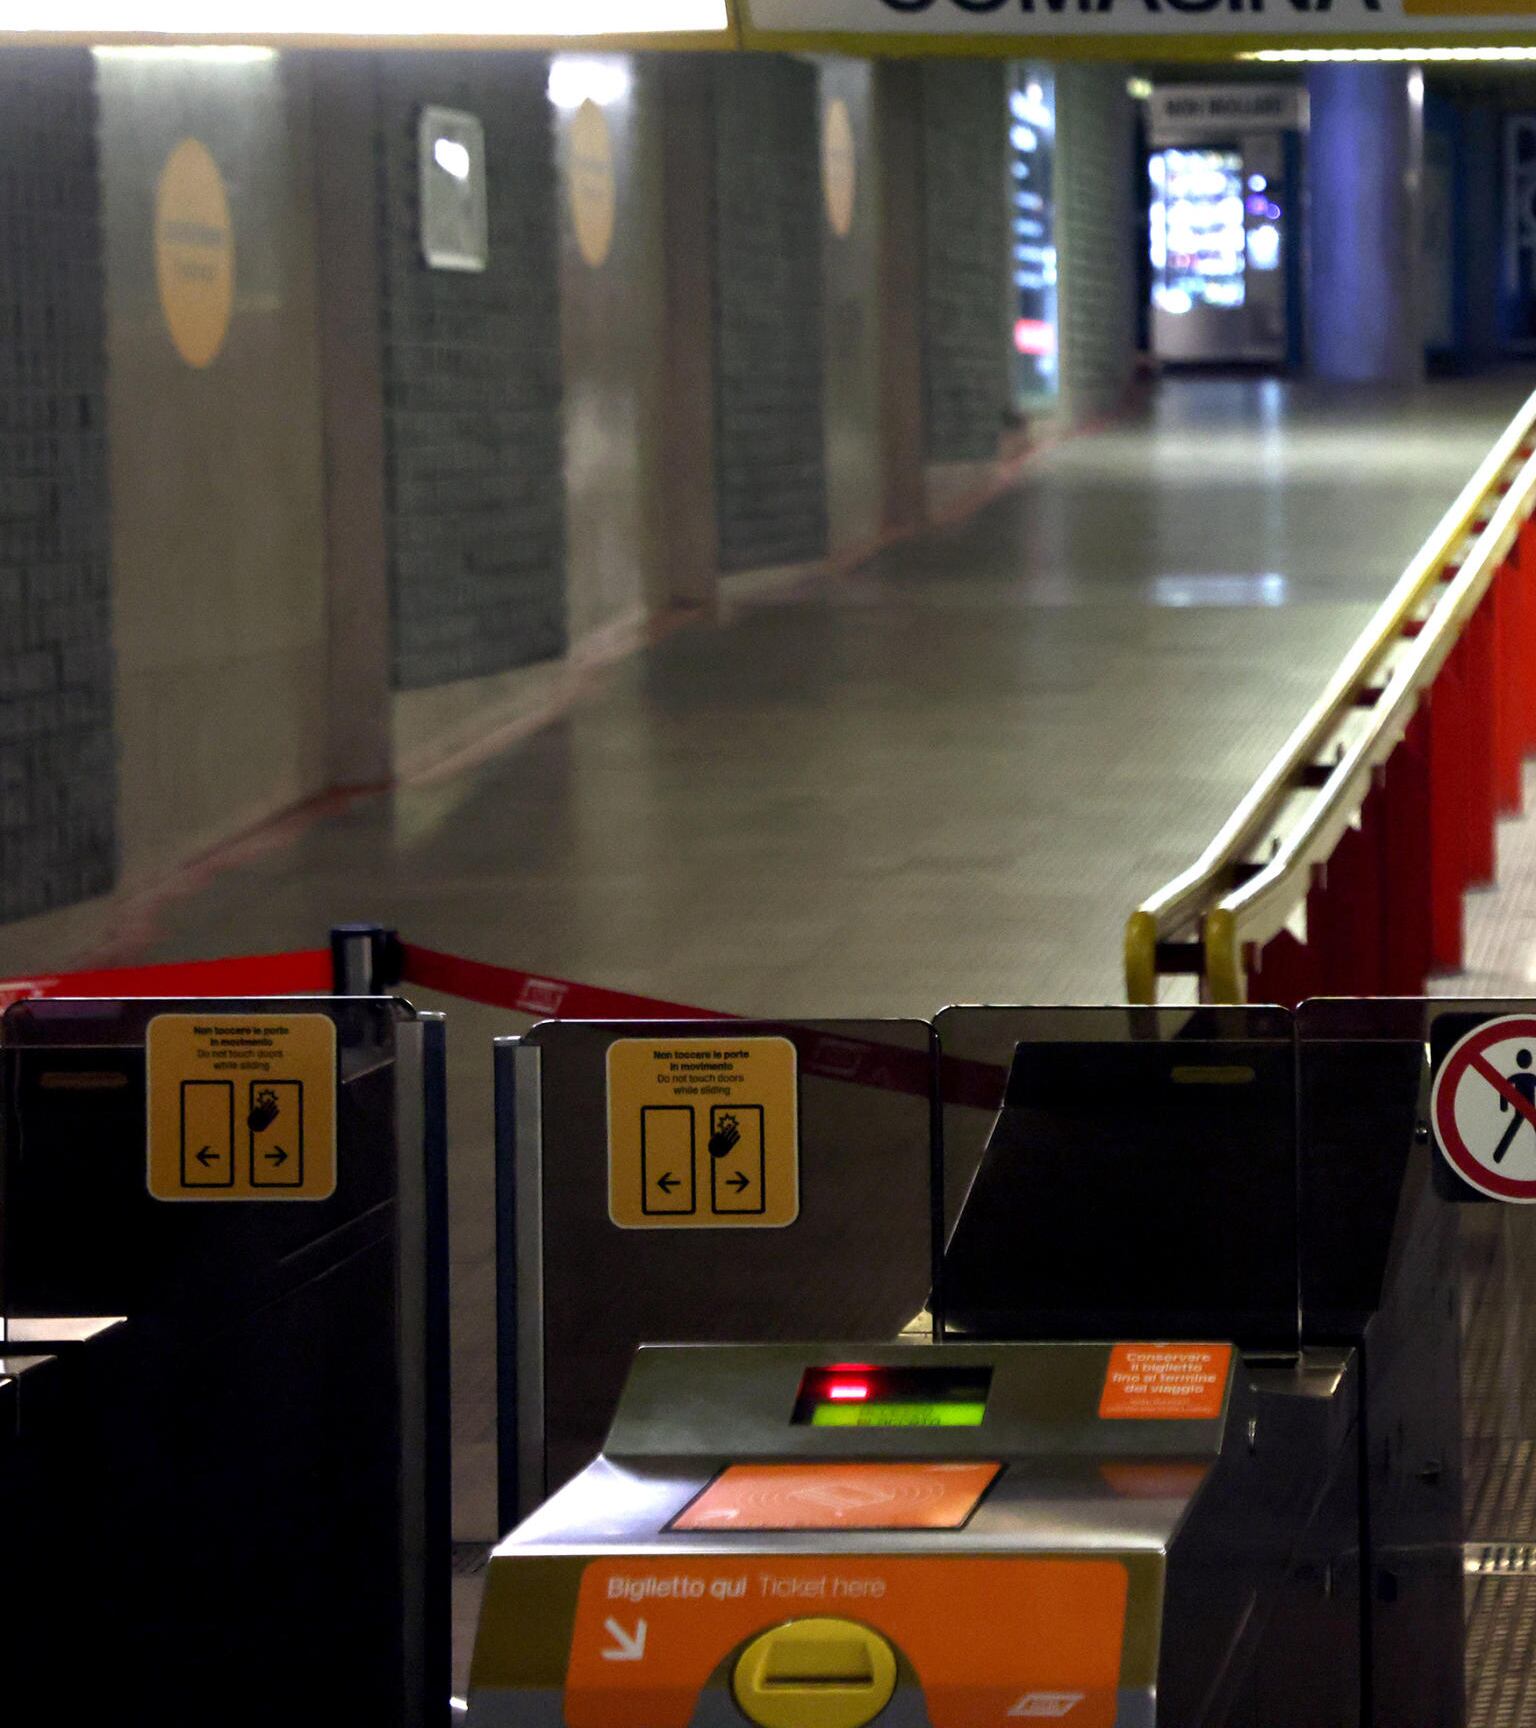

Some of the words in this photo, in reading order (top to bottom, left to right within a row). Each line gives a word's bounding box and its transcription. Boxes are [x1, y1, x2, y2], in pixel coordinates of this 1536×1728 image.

[194, 1026, 213, 1035] Non
[214, 1026, 251, 1036] toccare
[263, 1026, 289, 1036] porte
[221, 1038, 273, 1047] movimento
[197, 1049, 210, 1058] Do
[211, 1050, 227, 1058] not
[653, 1050, 673, 1060] Non
[674, 1050, 712, 1060] toccare
[713, 1050, 722, 1060] le
[723, 1050, 750, 1060] porte
[669, 1062, 679, 1072] in
[680, 1062, 735, 1072] movimento
[656, 1074, 670, 1083] Do
[672, 1074, 688, 1083] not
[688, 1074, 717, 1083] touch
[717, 1073, 745, 1083] doors
[673, 1086, 699, 1095] while
[700, 1086, 731, 1097] sliding
[1126, 1352, 1211, 1363] Conservare
[1142, 1362, 1203, 1374] biglietto
[1112, 1371, 1140, 1383] fino
[1142, 1372, 1157, 1383] al
[1160, 1372, 1217, 1383] termine
[1124, 1384, 1147, 1394] del
[1150, 1384, 1205, 1396] viaggio
[607, 1575, 704, 1602] Biglietto
[710, 1576, 748, 1601] qui
[759, 1575, 827, 1598] Ticket
[832, 1576, 886, 1599] here
